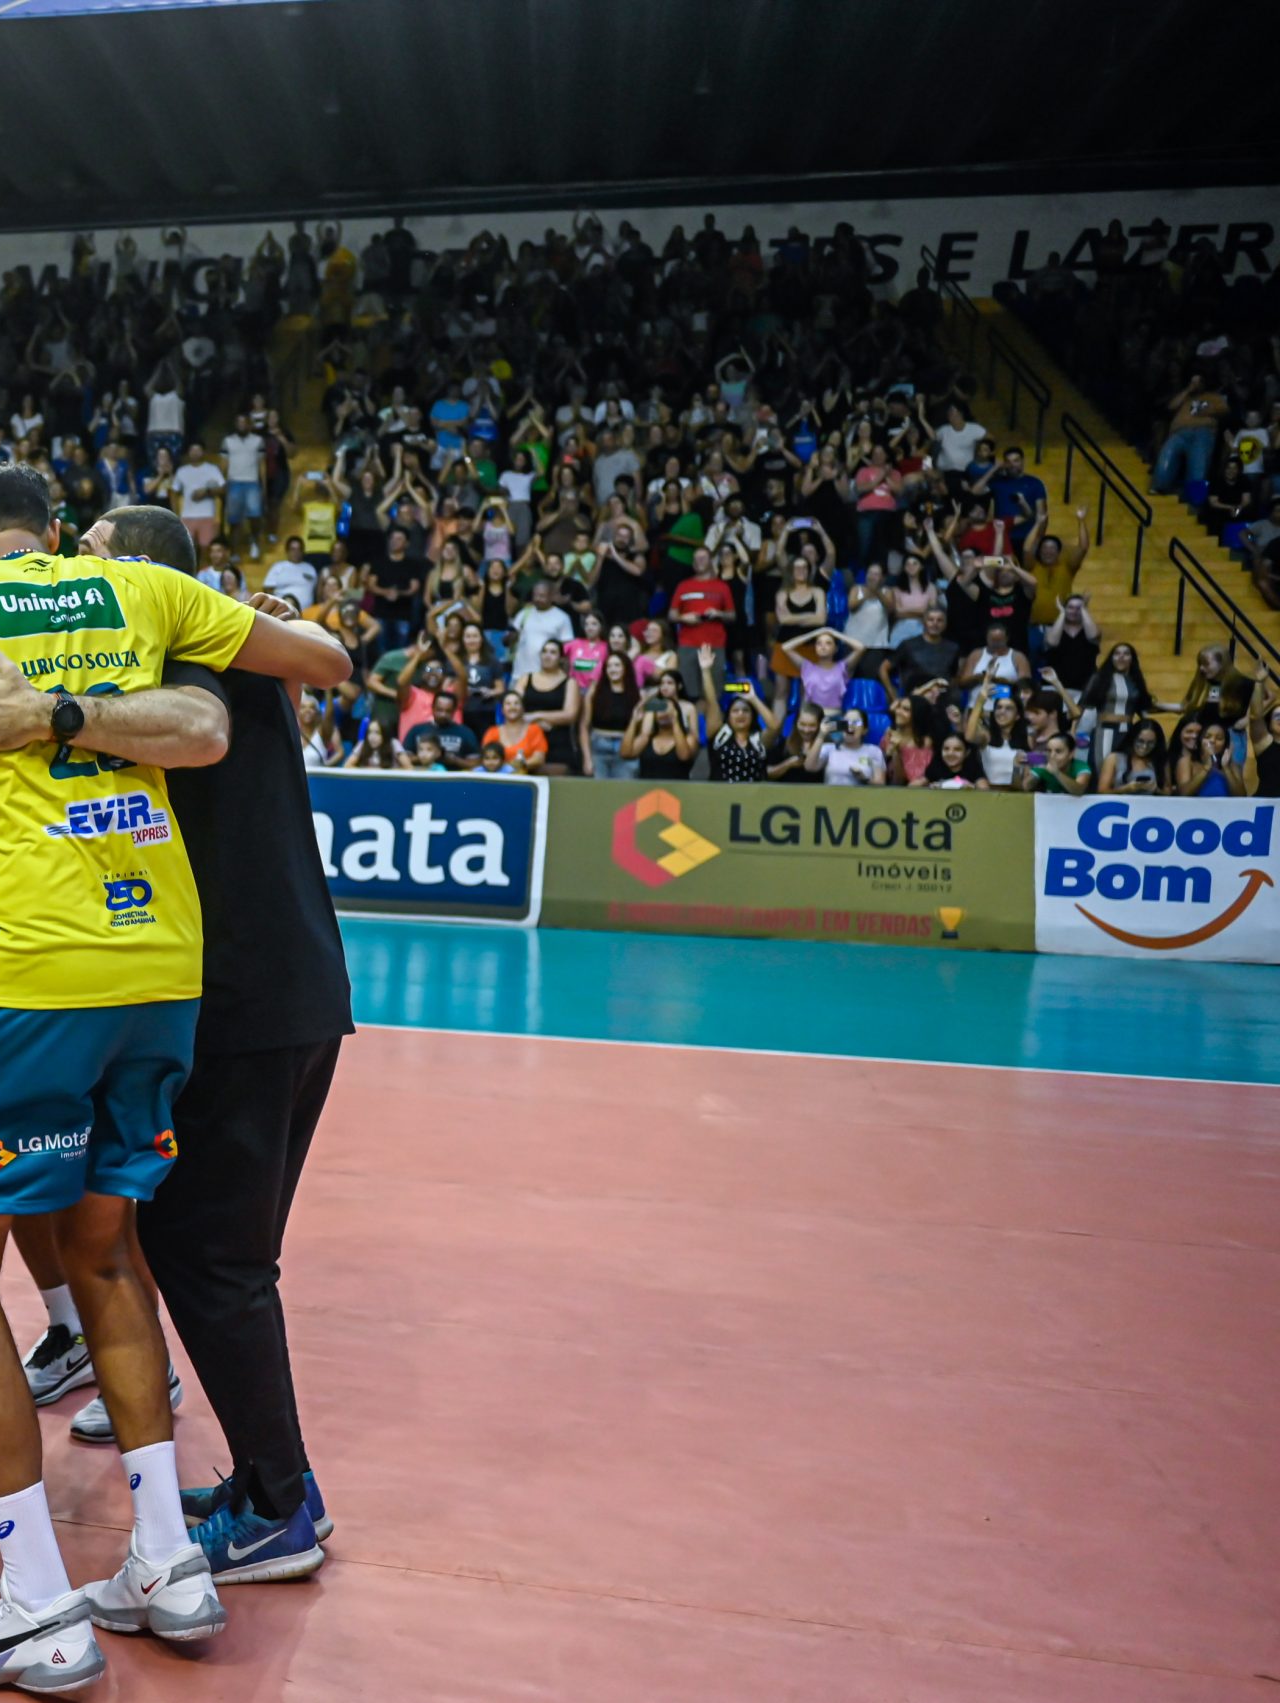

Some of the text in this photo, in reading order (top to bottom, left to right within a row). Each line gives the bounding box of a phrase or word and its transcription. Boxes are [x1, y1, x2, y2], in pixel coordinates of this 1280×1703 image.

[0, 591, 82, 613] Unimed
[85, 650, 140, 670] SOUZA
[131, 825, 169, 845] EXPRESS
[729, 803, 801, 847] LG
[1077, 801, 1275, 858] Good
[857, 861, 953, 881] Imóveis
[1044, 847, 1212, 904] Bom
[18, 1136, 43, 1153] LG
